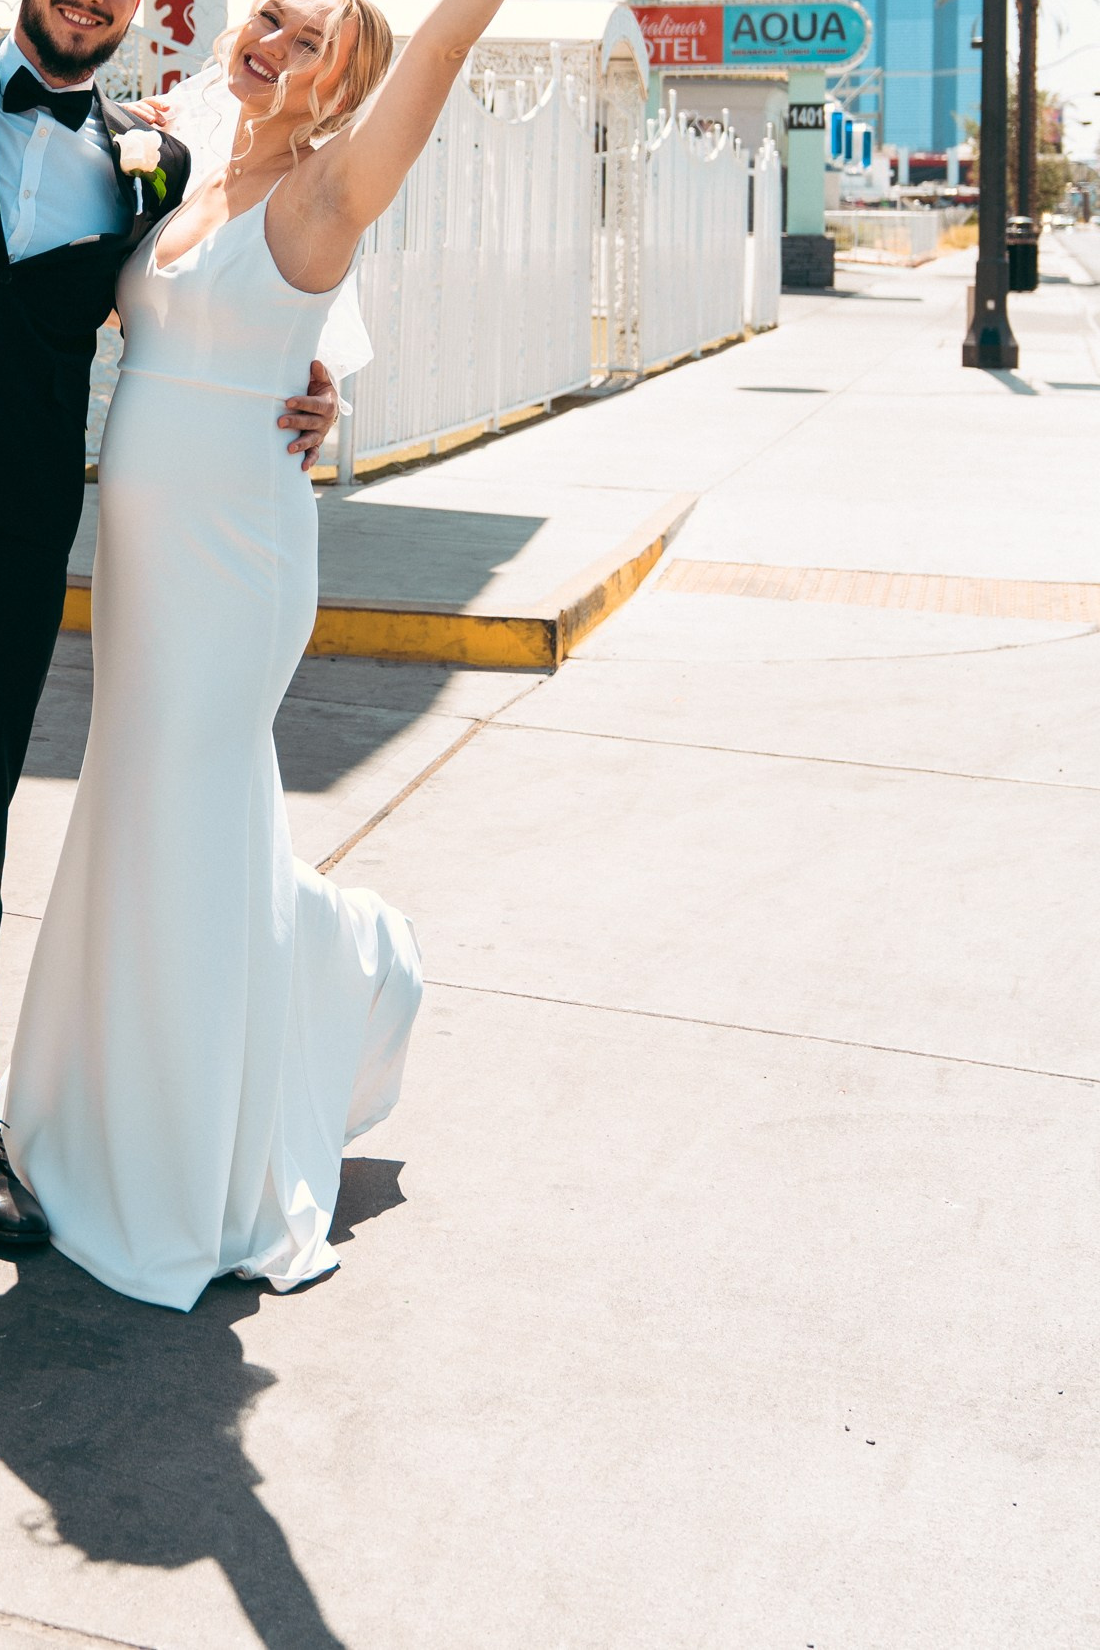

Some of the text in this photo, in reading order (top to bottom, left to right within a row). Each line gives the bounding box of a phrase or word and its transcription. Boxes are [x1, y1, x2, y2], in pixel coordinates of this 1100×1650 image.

[635, 11, 707, 37] halimar
[732, 12, 847, 46] AQUA
[789, 106, 824, 127] 1401
